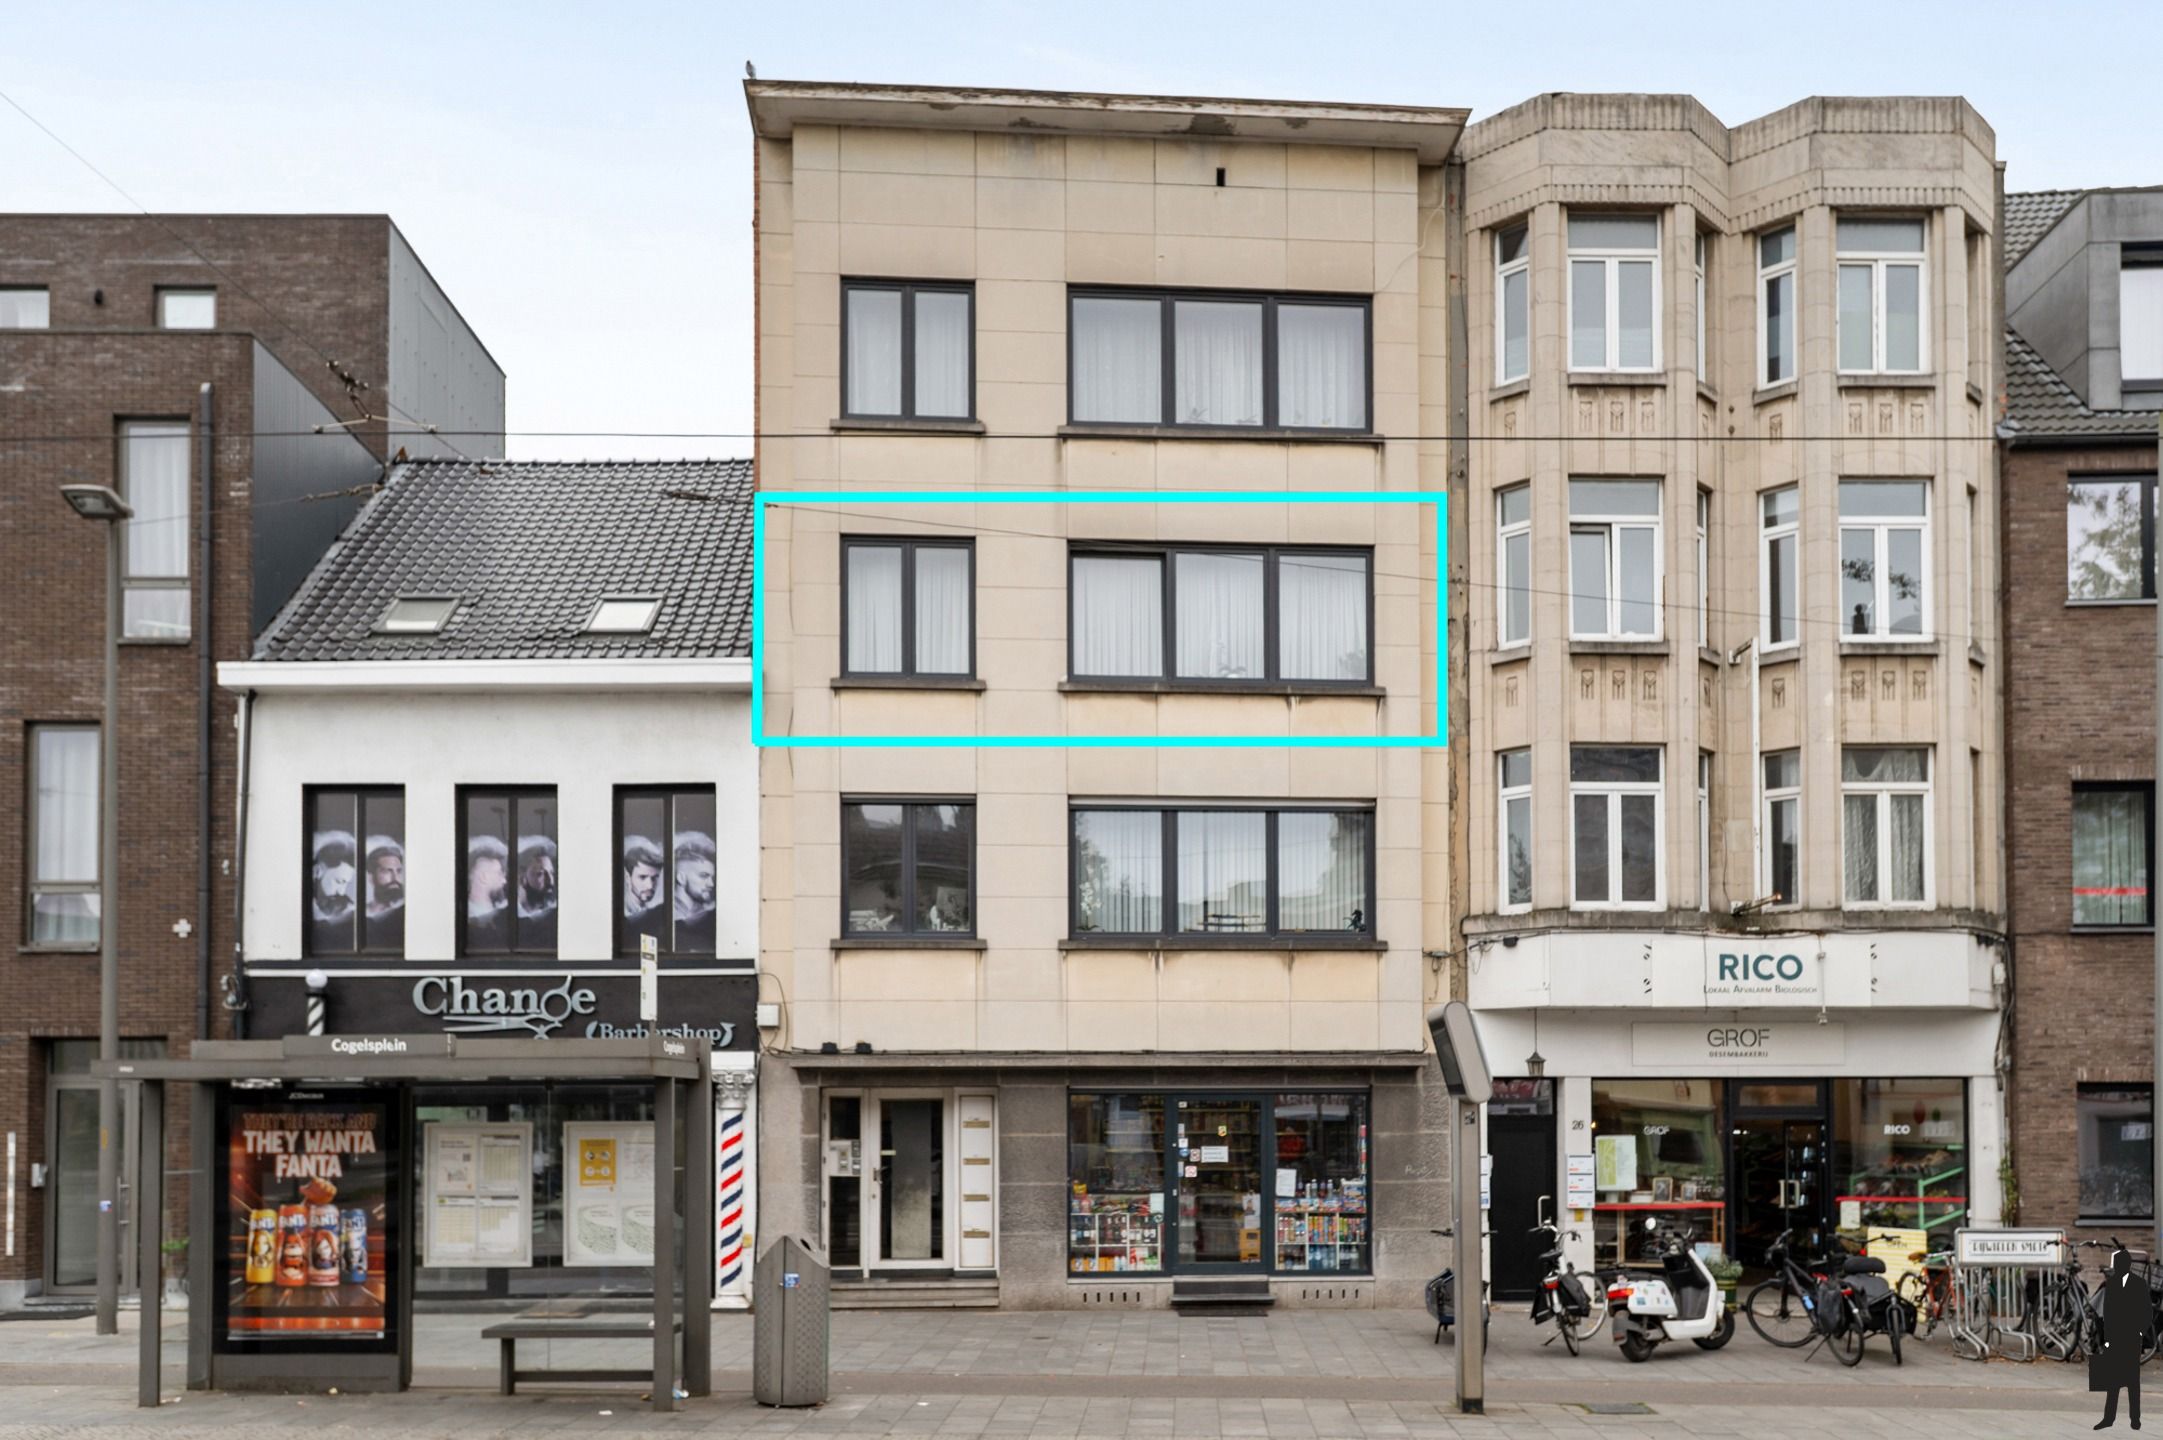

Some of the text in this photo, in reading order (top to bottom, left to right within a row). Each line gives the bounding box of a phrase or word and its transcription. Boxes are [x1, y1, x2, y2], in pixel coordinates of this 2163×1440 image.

[1719, 954, 1804, 981] RICO
[412, 974, 596, 1020] Change
[331, 1037, 407, 1055] Cogelsplein
[1707, 1028, 1771, 1047] GROF
[1572, 1120, 1584, 1130] 26
[1884, 1124, 1911, 1135] RICO
[243, 1131, 376, 1153] THEY WANTA
[276, 1154, 342, 1177] FANTA
